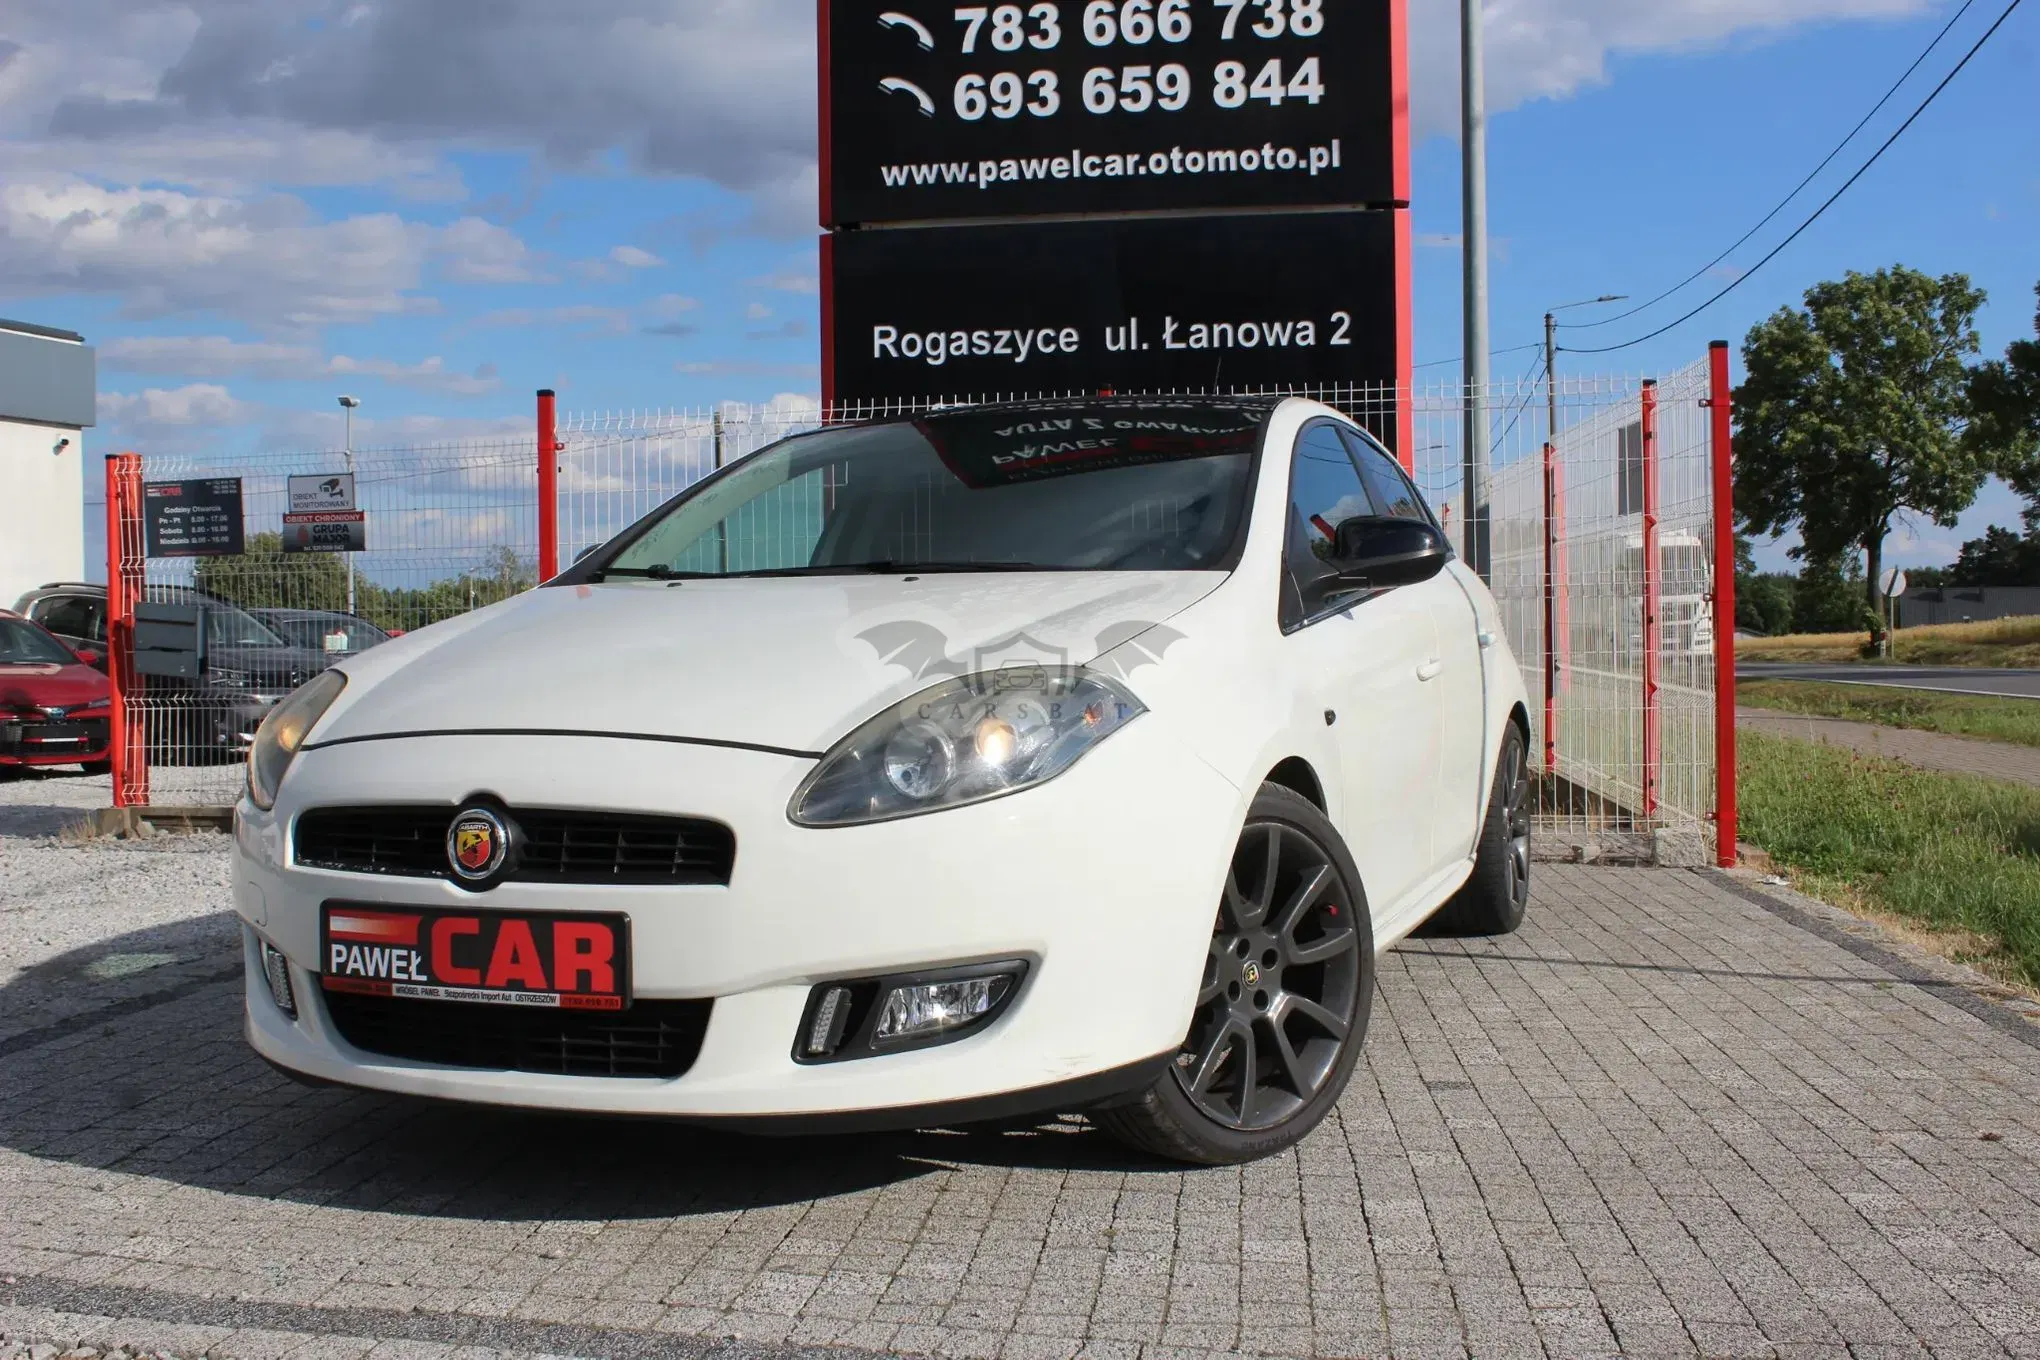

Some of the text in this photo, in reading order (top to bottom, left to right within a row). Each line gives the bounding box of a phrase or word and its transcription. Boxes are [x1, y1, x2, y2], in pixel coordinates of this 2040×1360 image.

[954, 0, 1324, 53] 783 666 738
[953, 57, 1325, 121] 693 659 844
[881, 139, 1341, 189] www.pawelcar.otomoto.pl
[873, 311, 1351, 365] Rogaszyce ul. Łanowa 2
[313, 524, 349, 534] GRUPA
[315, 514, 360, 522] CHRONIONY
[331, 917, 614, 992] PAWEŁ CAR
[481, 991, 500, 1002] Import
